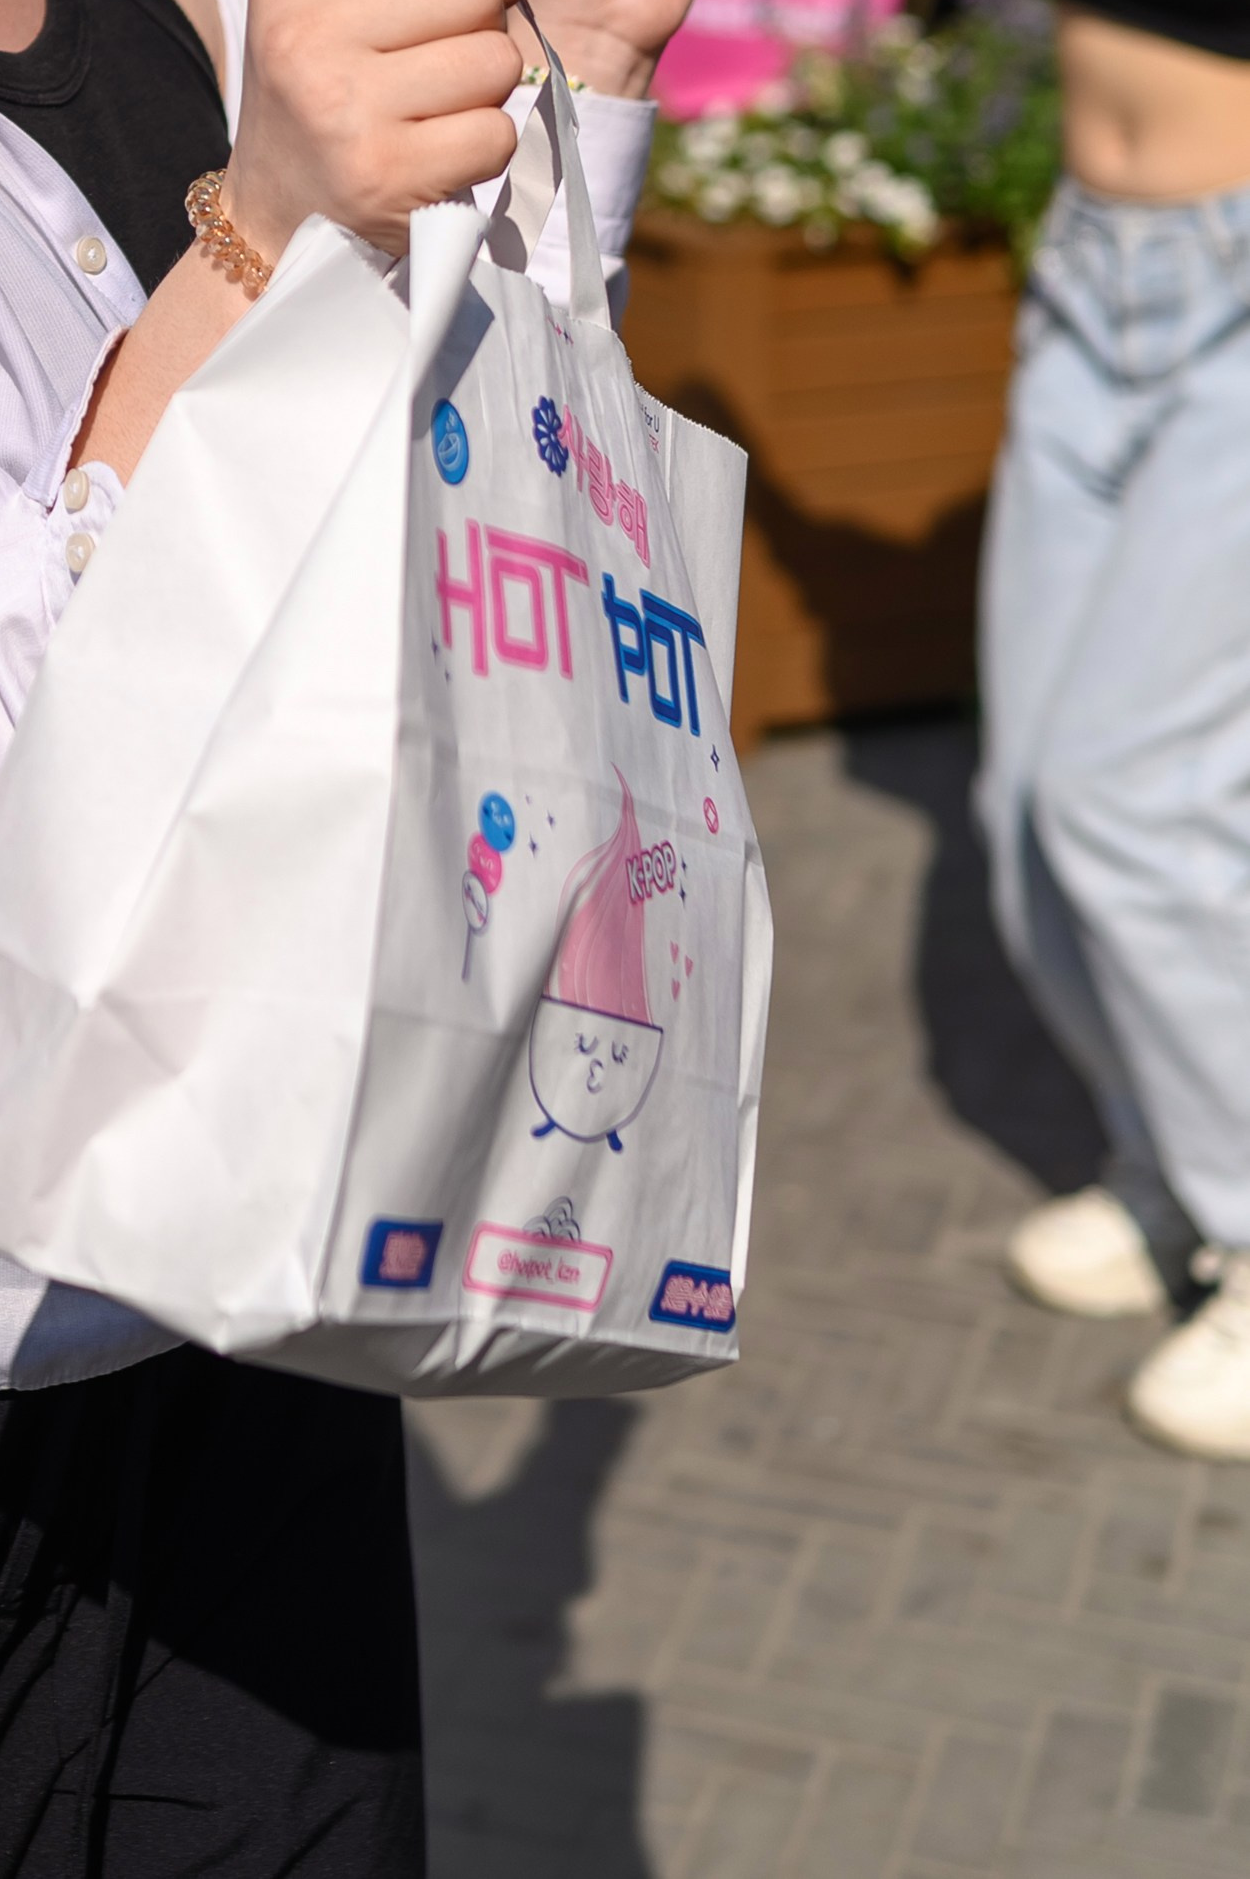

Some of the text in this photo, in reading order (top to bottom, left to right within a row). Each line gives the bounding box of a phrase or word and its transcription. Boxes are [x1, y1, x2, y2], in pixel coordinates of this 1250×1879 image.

[557, 403, 651, 569] 사랑해
[436, 517, 706, 737] HOT POT
[625, 840, 676, 904] K-POP
